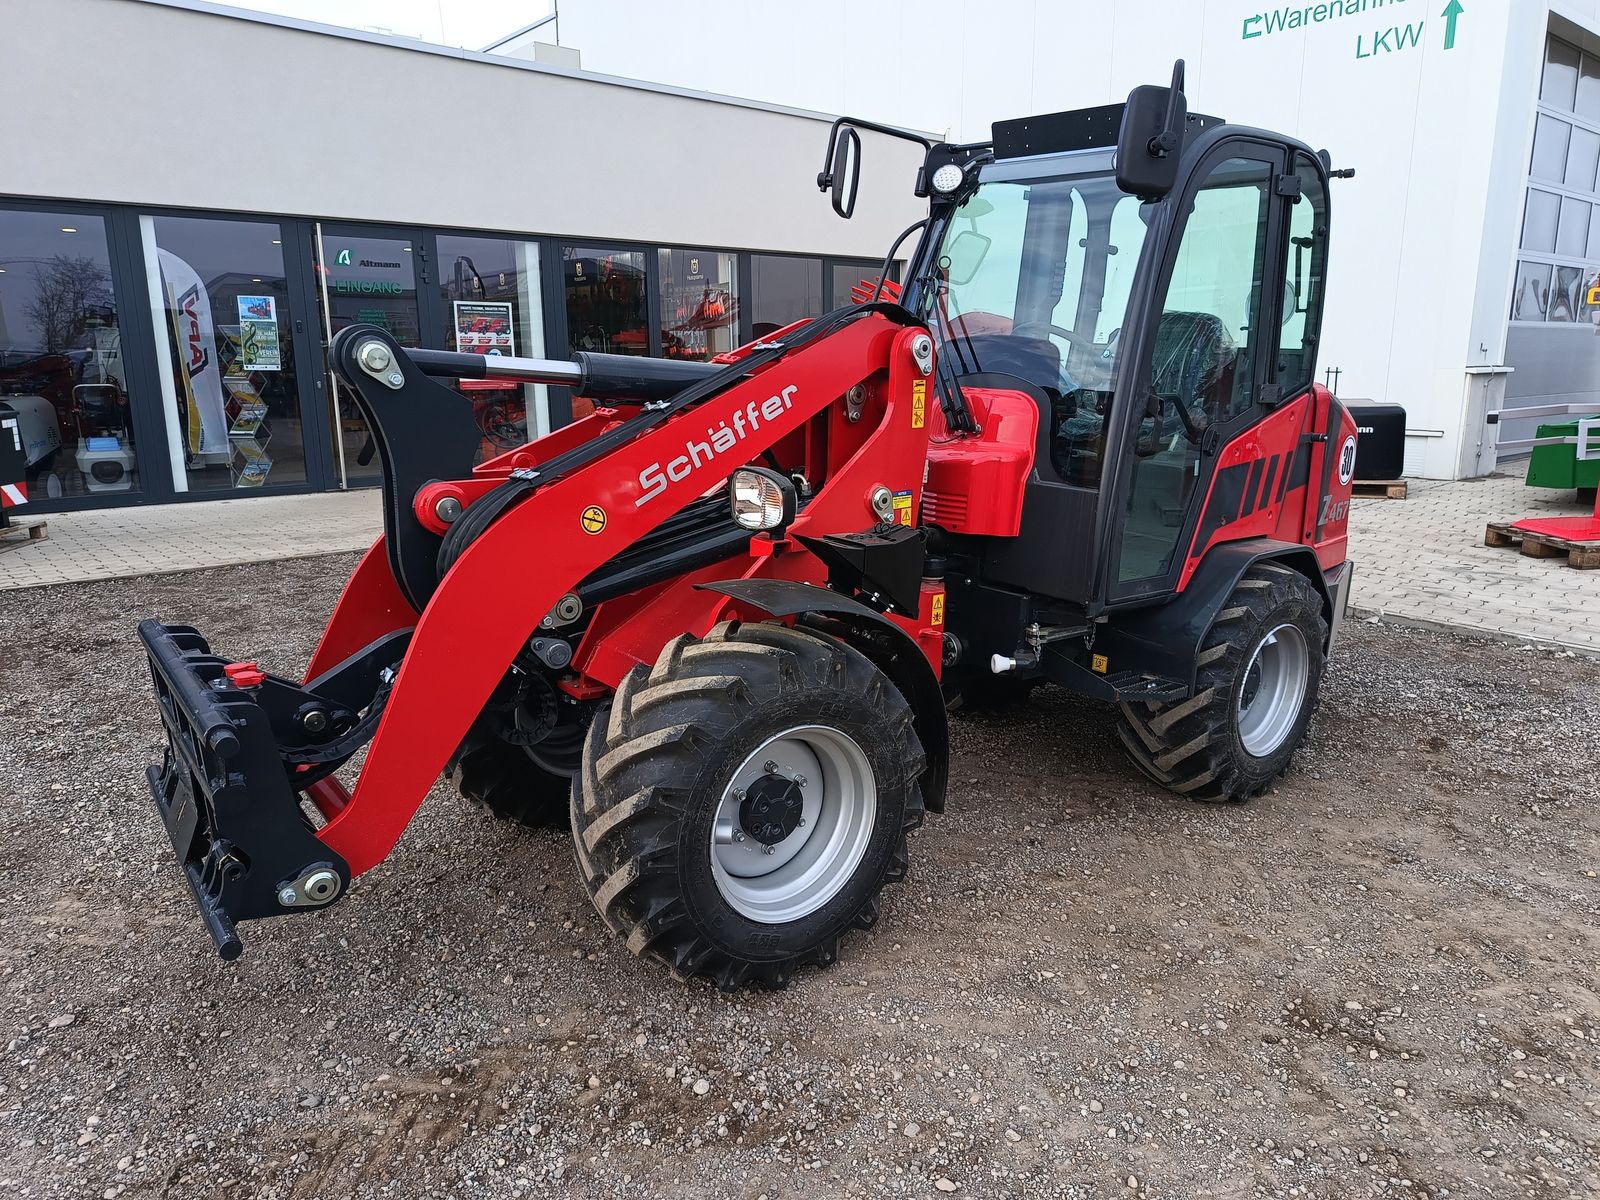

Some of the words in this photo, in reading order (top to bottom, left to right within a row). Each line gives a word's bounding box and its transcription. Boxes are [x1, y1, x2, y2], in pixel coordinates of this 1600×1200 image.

[1264, 0, 1406, 34] Warenan
[1356, 21, 1425, 59] LKW
[359, 259, 401, 269] Altmann
[336, 280, 403, 294] EINGANG
[634, 384, 798, 508] Schäffer
[1341, 445, 1354, 476] 30
